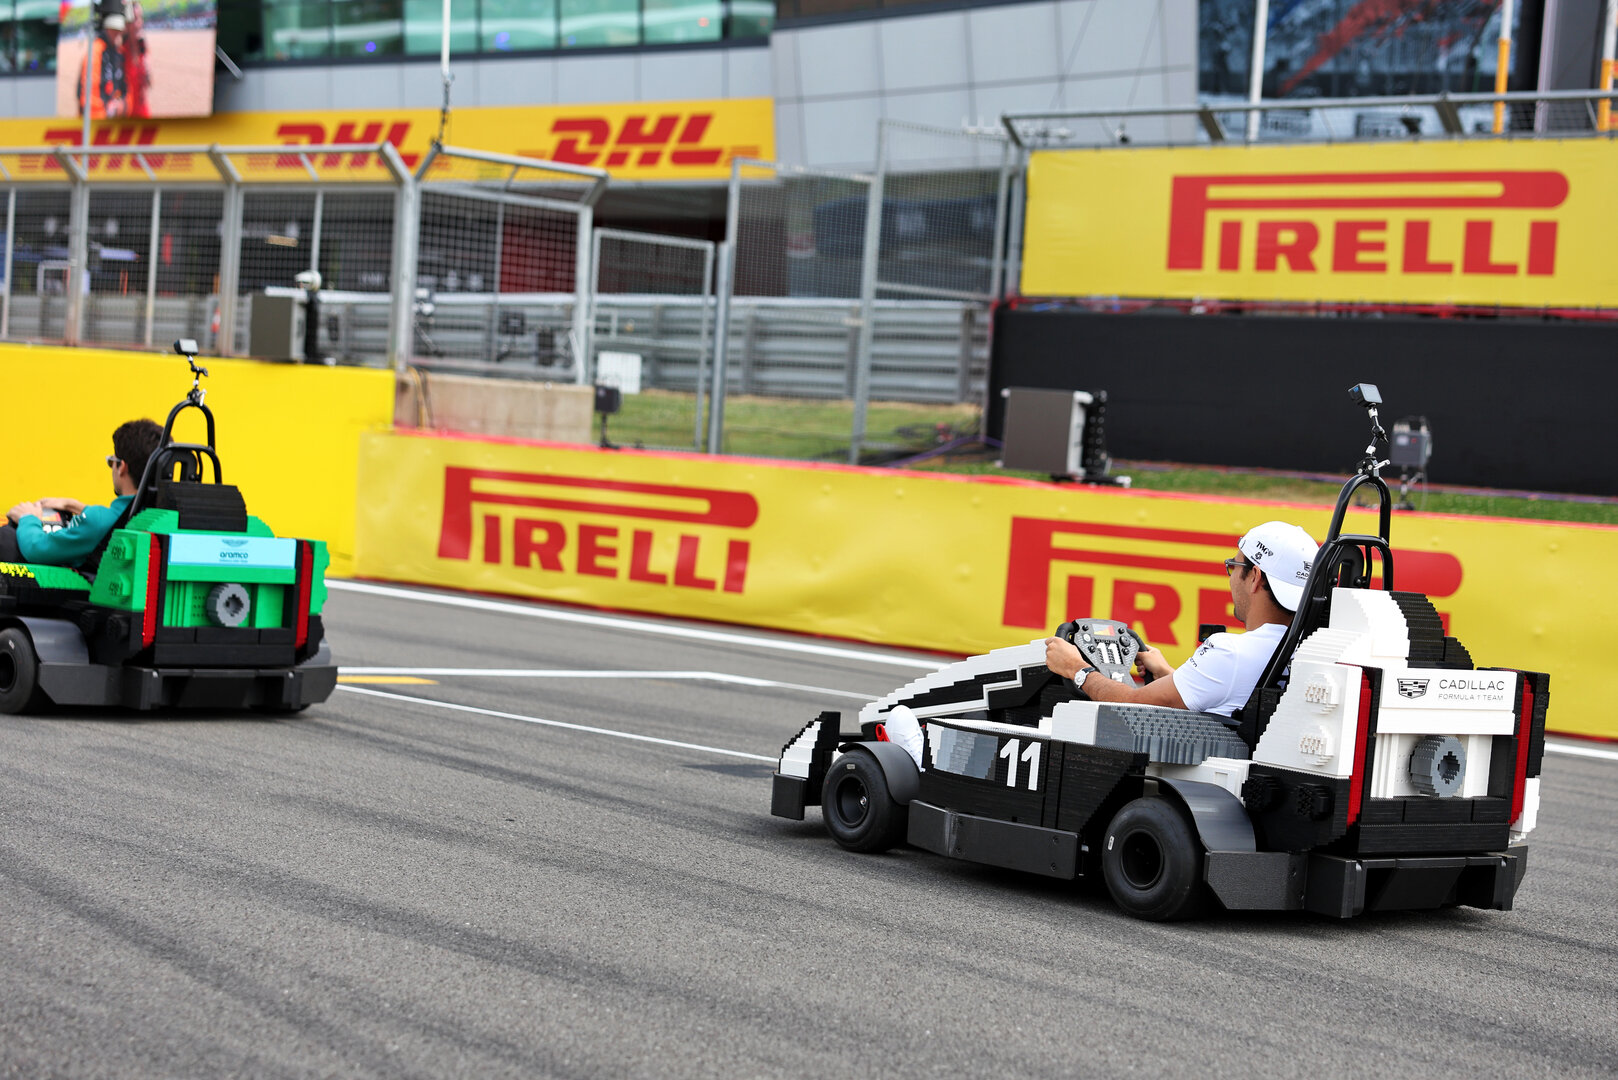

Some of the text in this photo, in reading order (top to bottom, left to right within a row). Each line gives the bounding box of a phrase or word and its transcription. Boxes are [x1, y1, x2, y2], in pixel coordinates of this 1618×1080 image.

[276, 121, 419, 169] DHL
[551, 113, 723, 167] DHL
[1166, 170, 1570, 277] PIRELLI
[219, 551, 249, 559] aramco
[437, 466, 760, 594] PIRELLI
[1002, 516, 1463, 648] PIRE
[1097, 642, 1122, 665] 11
[1438, 693, 1475, 701] FORMULA
[1439, 679, 1505, 691] CADILLAC
[1000, 738, 1042, 791] 11
